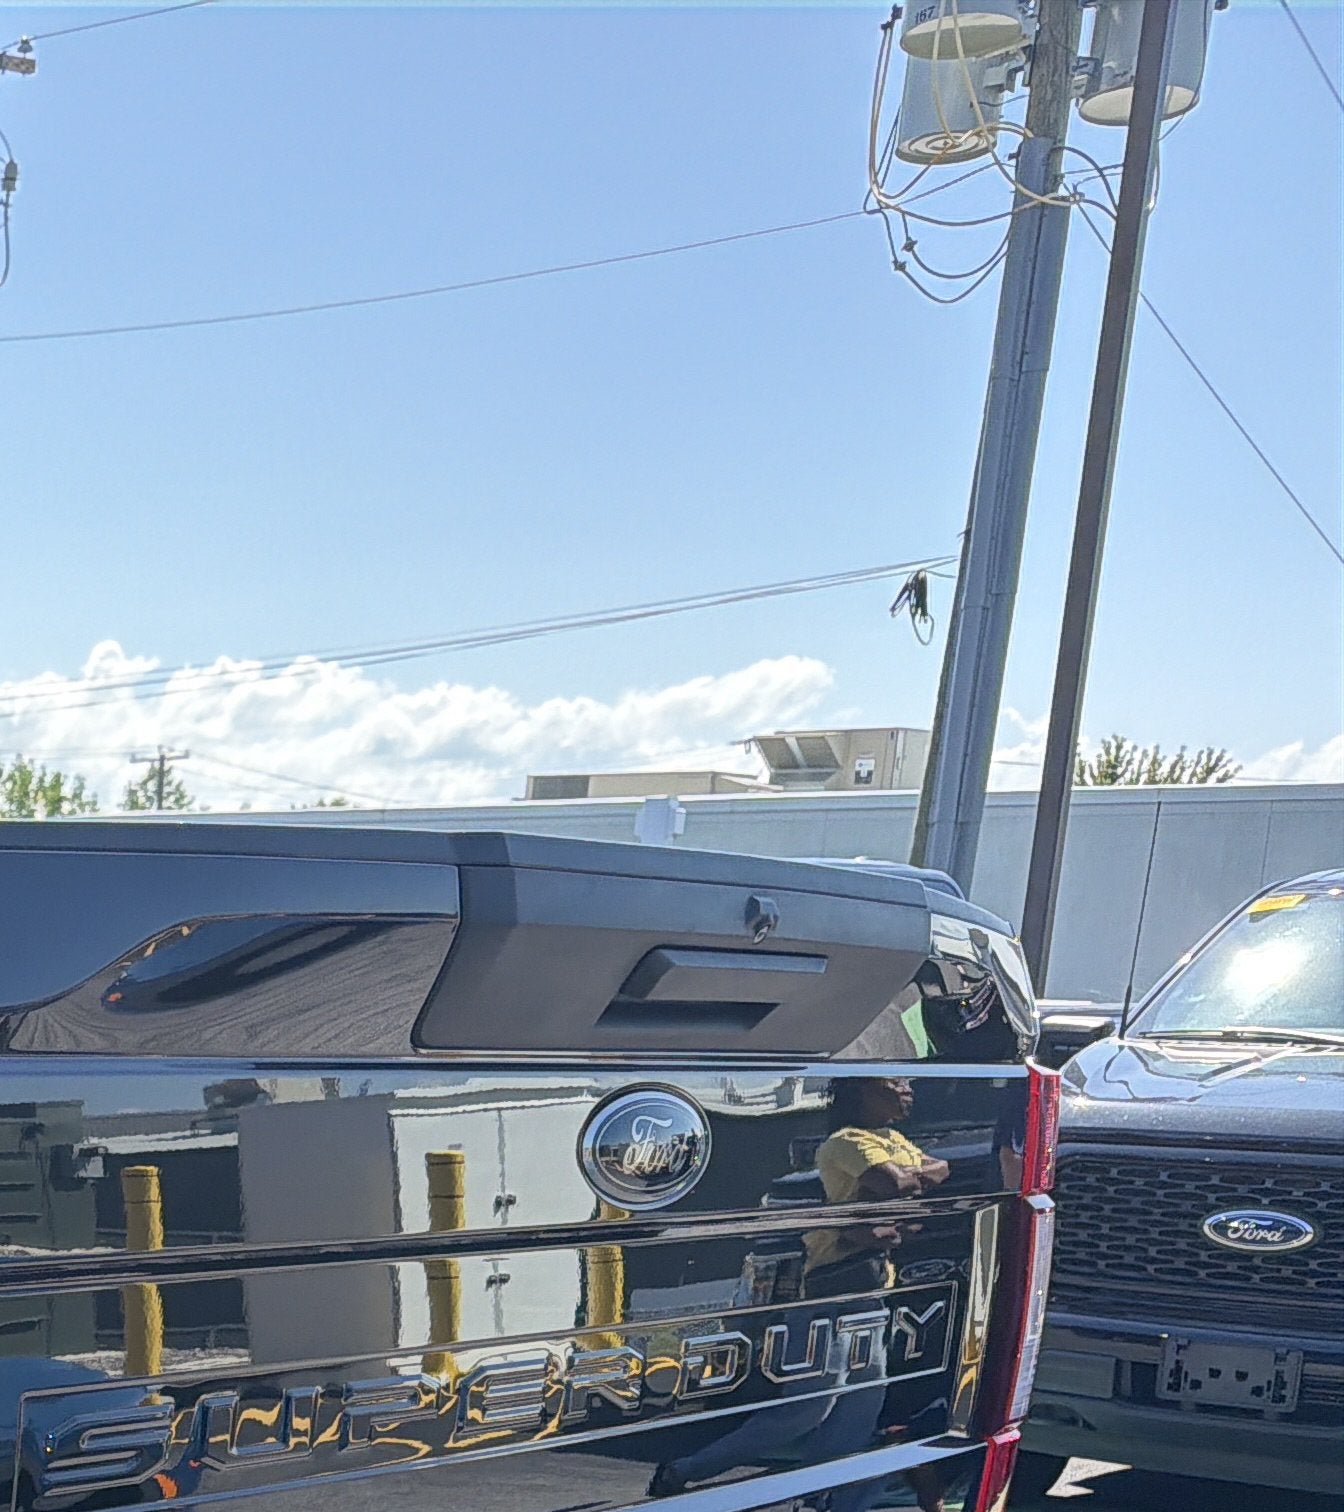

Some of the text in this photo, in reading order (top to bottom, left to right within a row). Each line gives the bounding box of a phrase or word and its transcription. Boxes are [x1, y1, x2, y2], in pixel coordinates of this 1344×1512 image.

[623, 1115, 688, 1174] Ford
[1227, 1217, 1287, 1242] Ford
[42, 1300, 945, 1498] SUPER DUTY
